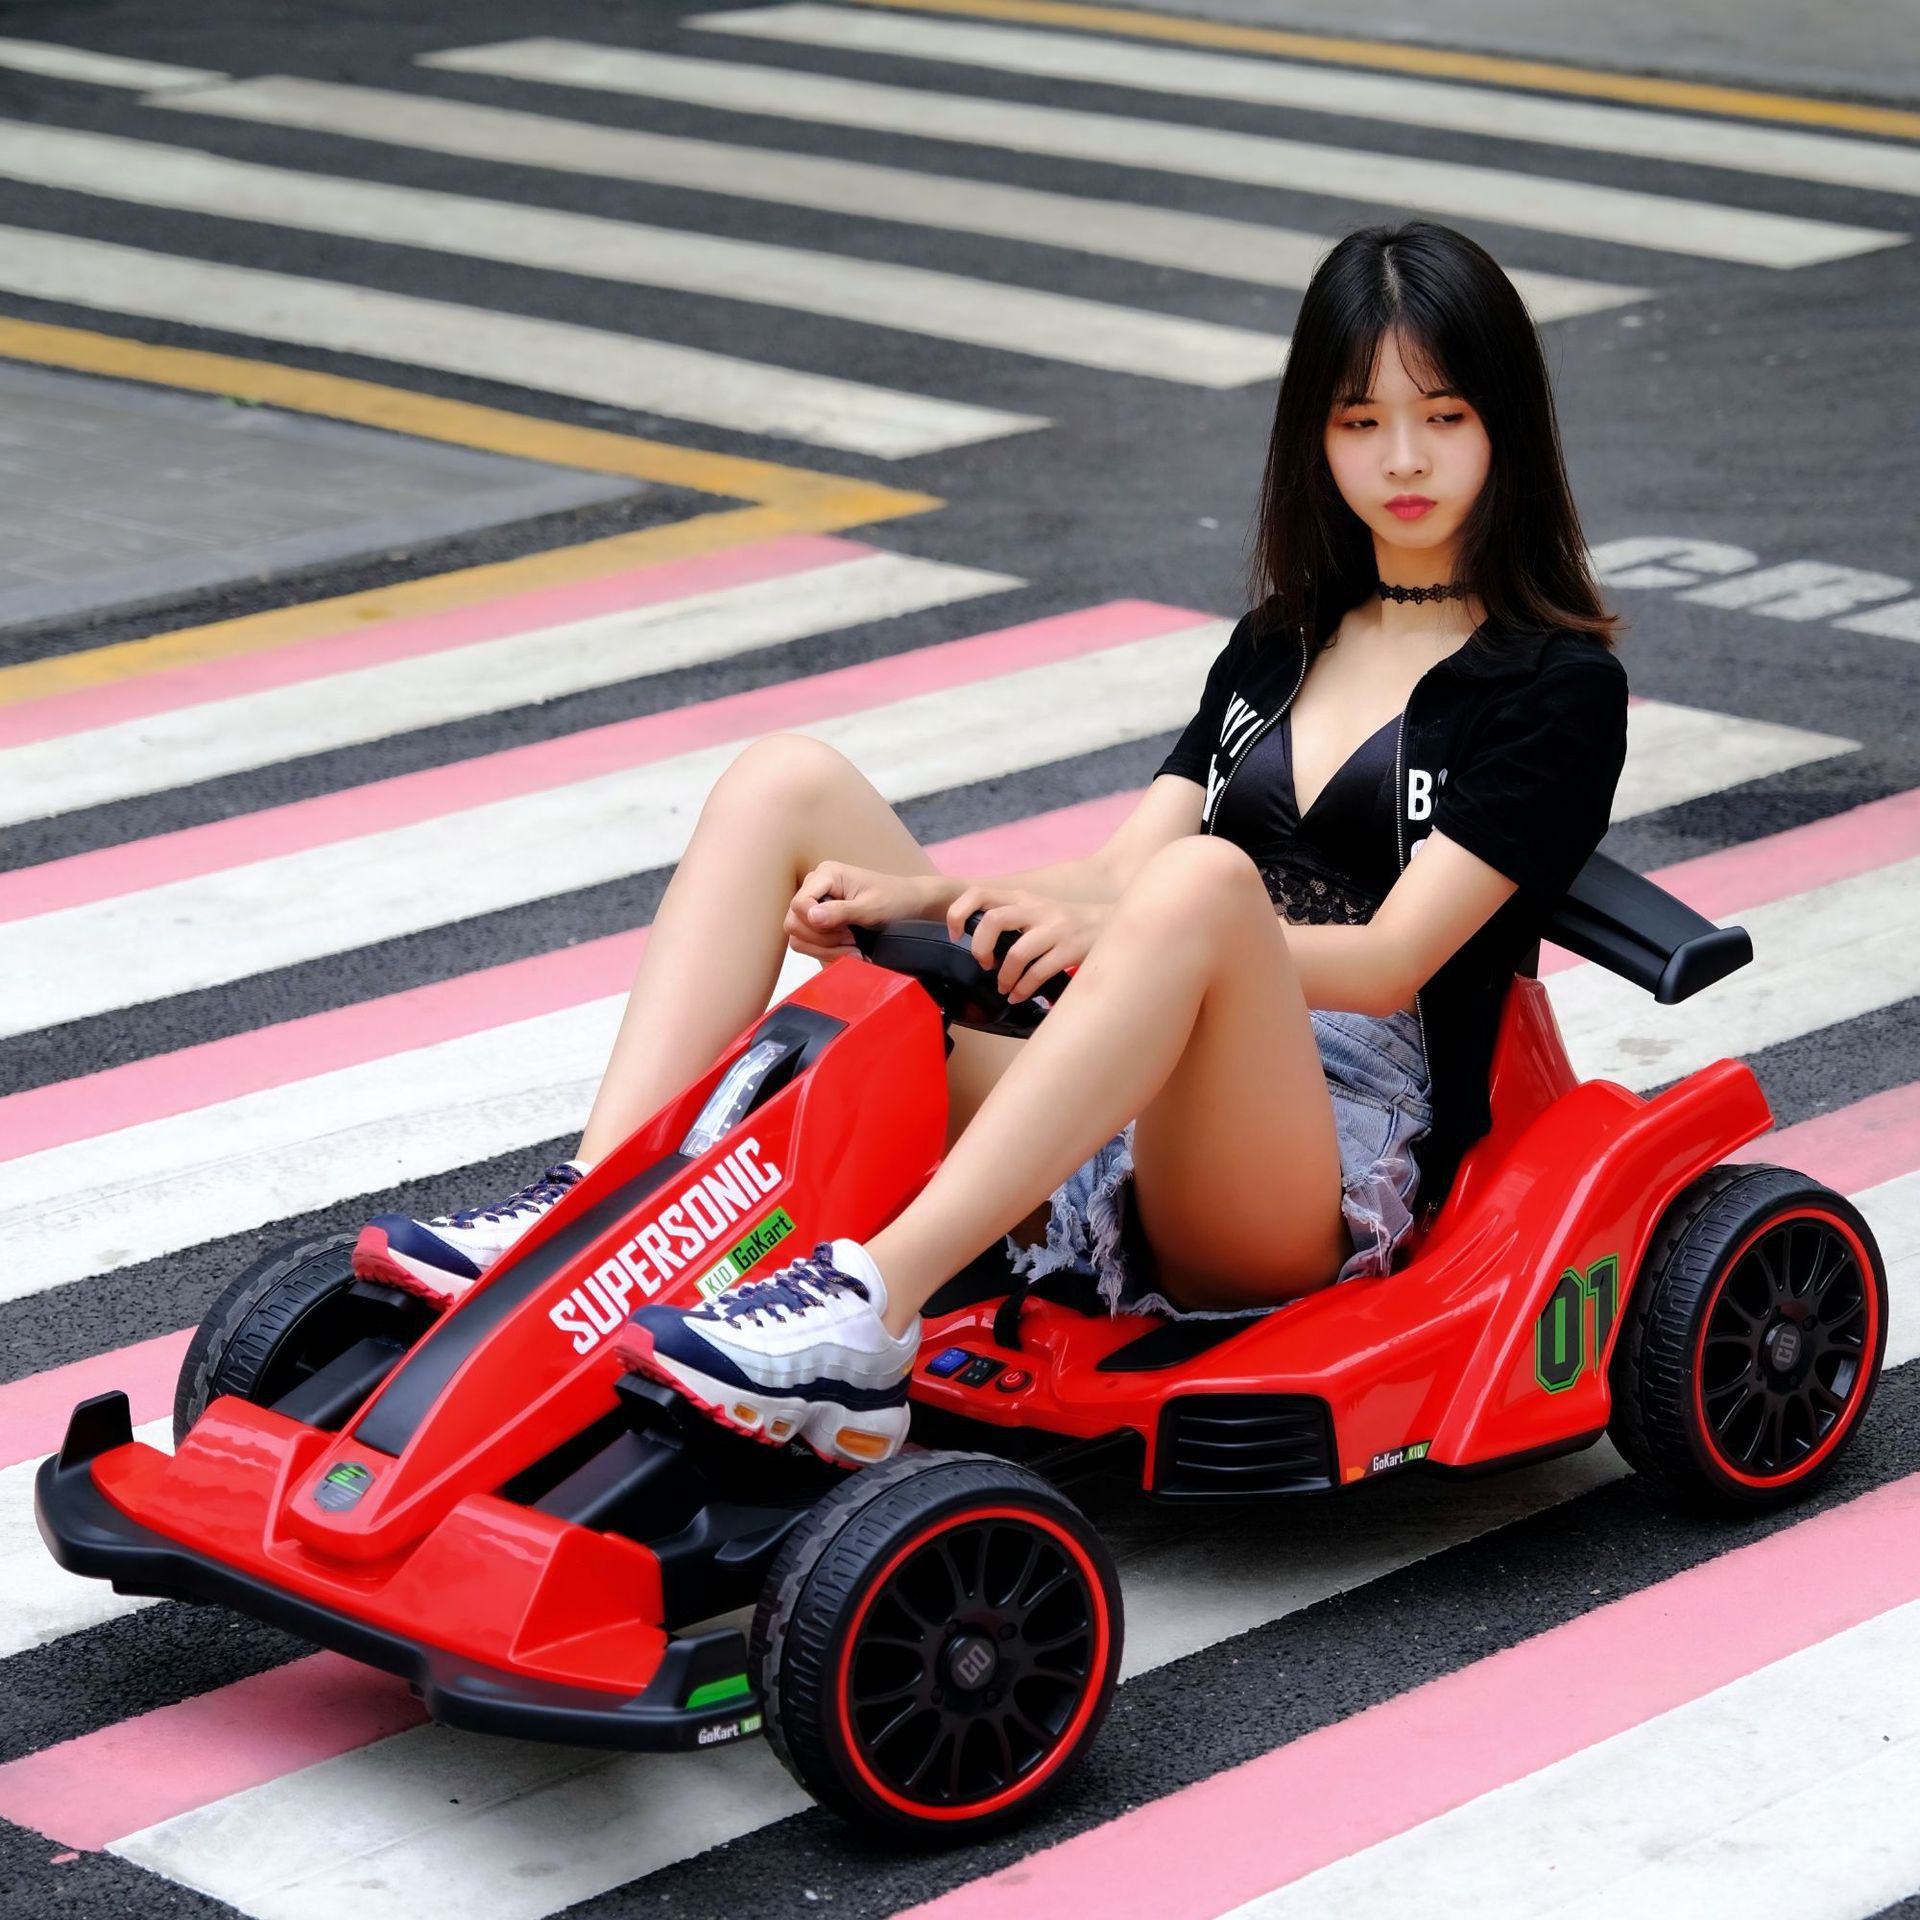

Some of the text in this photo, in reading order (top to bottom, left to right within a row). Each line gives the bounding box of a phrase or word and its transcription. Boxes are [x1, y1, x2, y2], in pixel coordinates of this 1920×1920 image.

[549, 1137, 782, 1355] SUPERSONIC
[704, 1215, 793, 1295] KID GoKart
[1535, 1253, 1618, 1394] 01
[1373, 1445, 1425, 1472] GoKart KID
[957, 1645, 991, 1684] GO
[698, 1723, 739, 1744] GoKart
